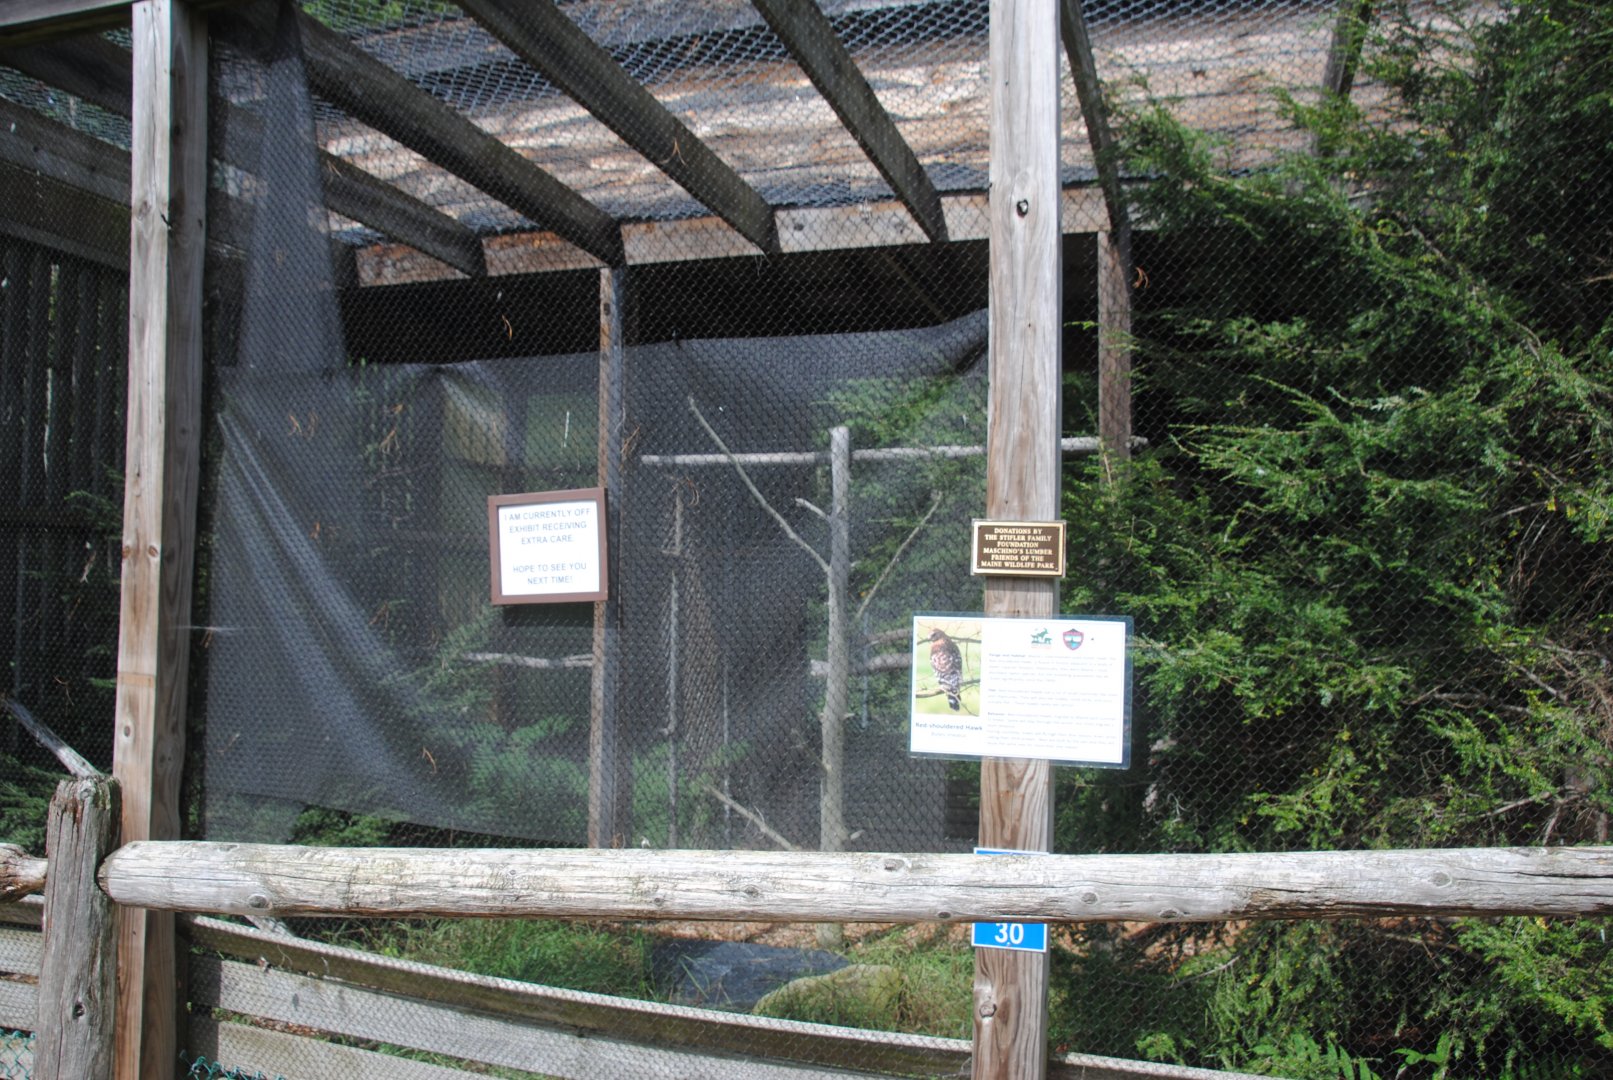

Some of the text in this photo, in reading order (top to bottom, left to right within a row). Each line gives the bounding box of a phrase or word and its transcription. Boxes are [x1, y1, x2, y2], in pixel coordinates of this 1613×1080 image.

[509, 513, 521, 521] AM
[523, 509, 572, 520] CURRENTLY
[574, 508, 591, 517] OFF
[509, 521, 587, 534] EXHIBIT RECEIVING
[521, 536, 548, 545] EXTRA
[512, 561, 587, 573] HOPE TO SEE YOU
[527, 576, 548, 585] NEXT
[994, 922, 1024, 945] 30
